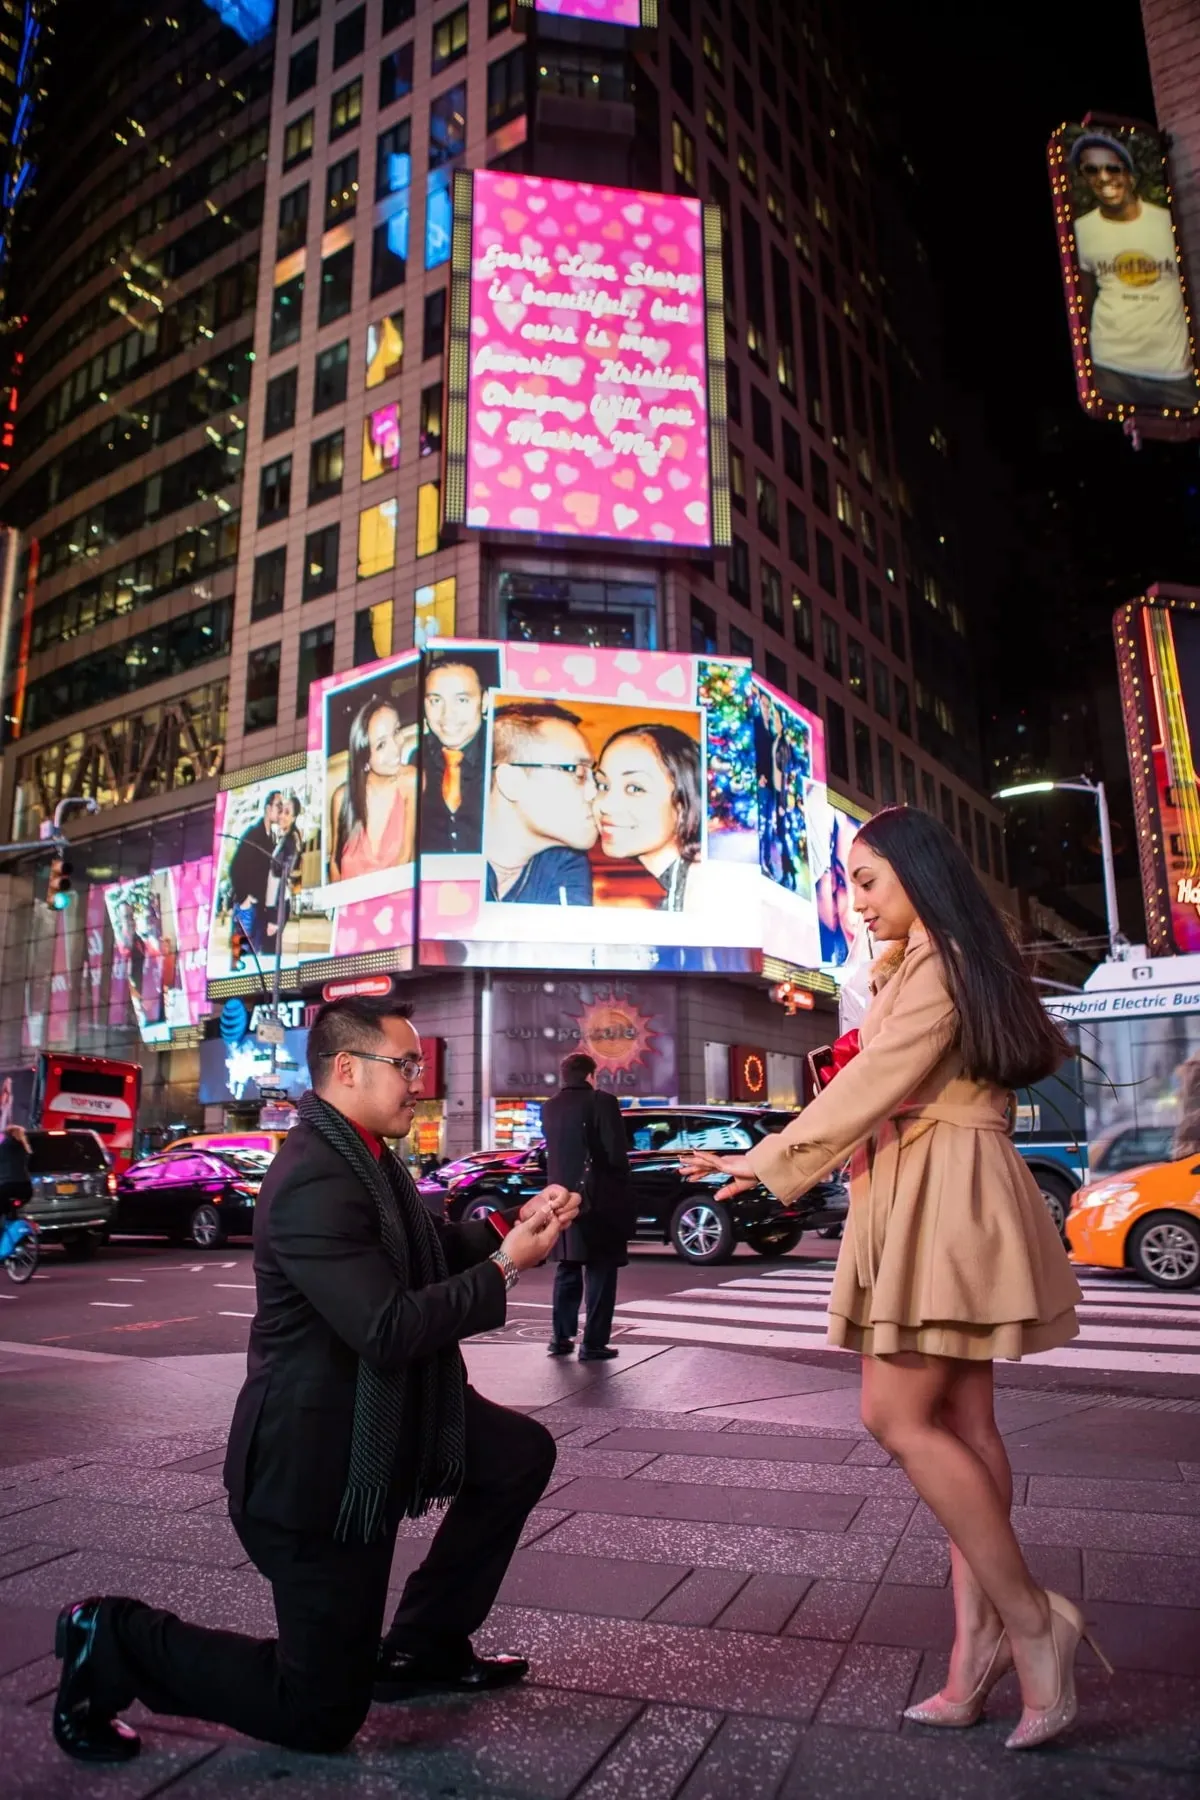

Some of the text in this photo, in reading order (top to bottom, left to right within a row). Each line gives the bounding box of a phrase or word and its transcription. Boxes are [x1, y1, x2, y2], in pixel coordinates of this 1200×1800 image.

[479, 244, 549, 277] Every
[558, 254, 618, 281] Love
[488, 278, 513, 302] is
[651, 298, 689, 323] but
[521, 324, 578, 344] ours
[586, 324, 612, 348] is
[649, 406, 695, 429] you
[507, 420, 602, 457] Marry
[1061, 999, 1107, 1017] Hybrid
[1112, 995, 1166, 1011] Electric
[1173, 992, 1200, 1005] Bus
